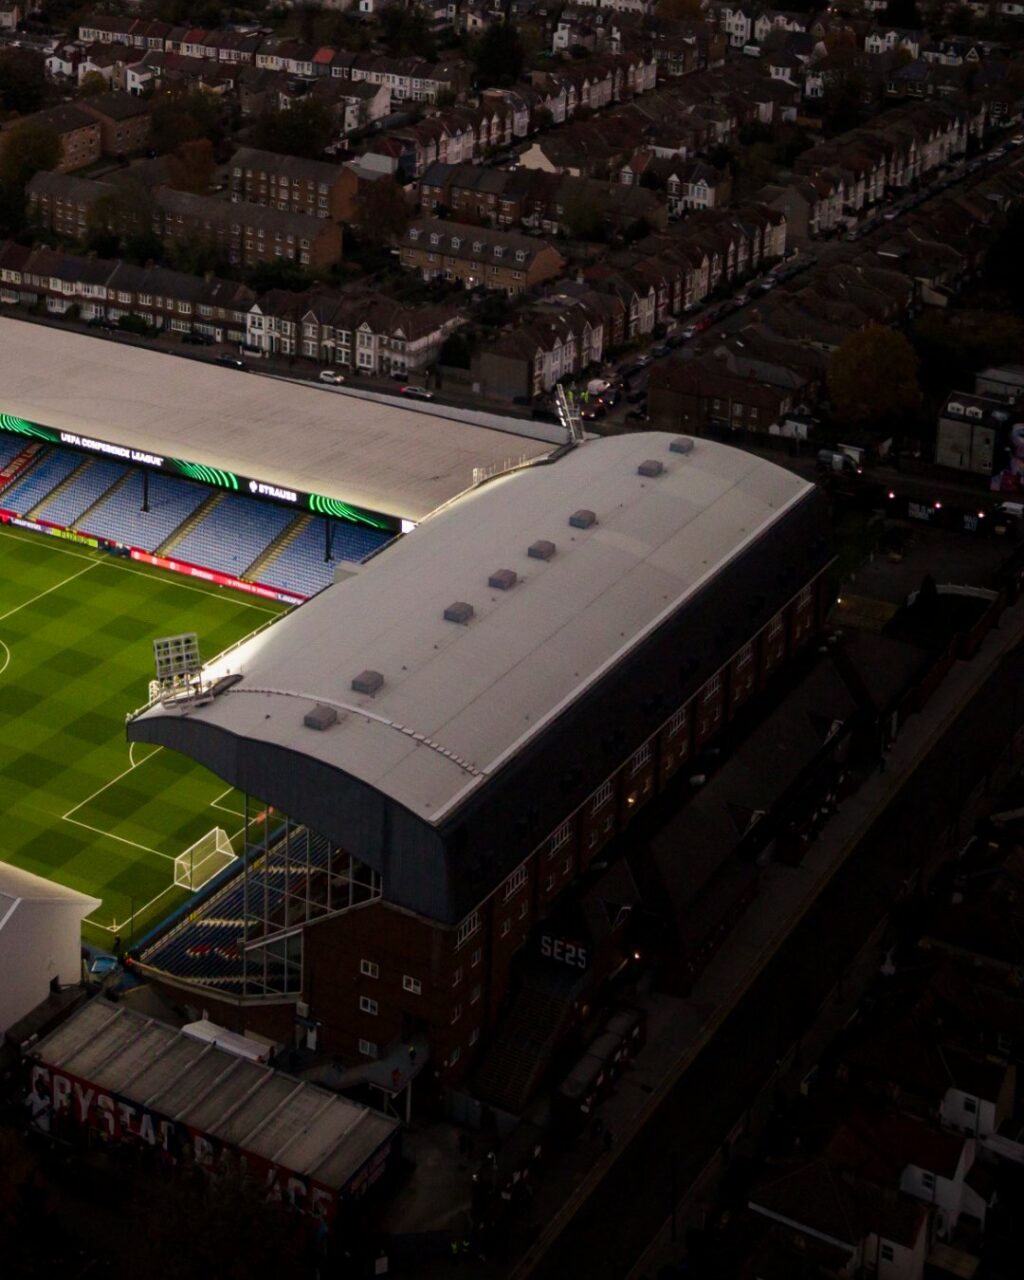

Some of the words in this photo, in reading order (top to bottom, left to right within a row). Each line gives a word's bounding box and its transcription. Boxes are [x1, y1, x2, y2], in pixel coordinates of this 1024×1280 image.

[60, 432, 81, 446] UEFA
[81, 438, 130, 458] CONFERENCE
[131, 450, 163, 466] LEAGUE
[258, 483, 297, 502] STRAUSS
[540, 934, 587, 969] SE25
